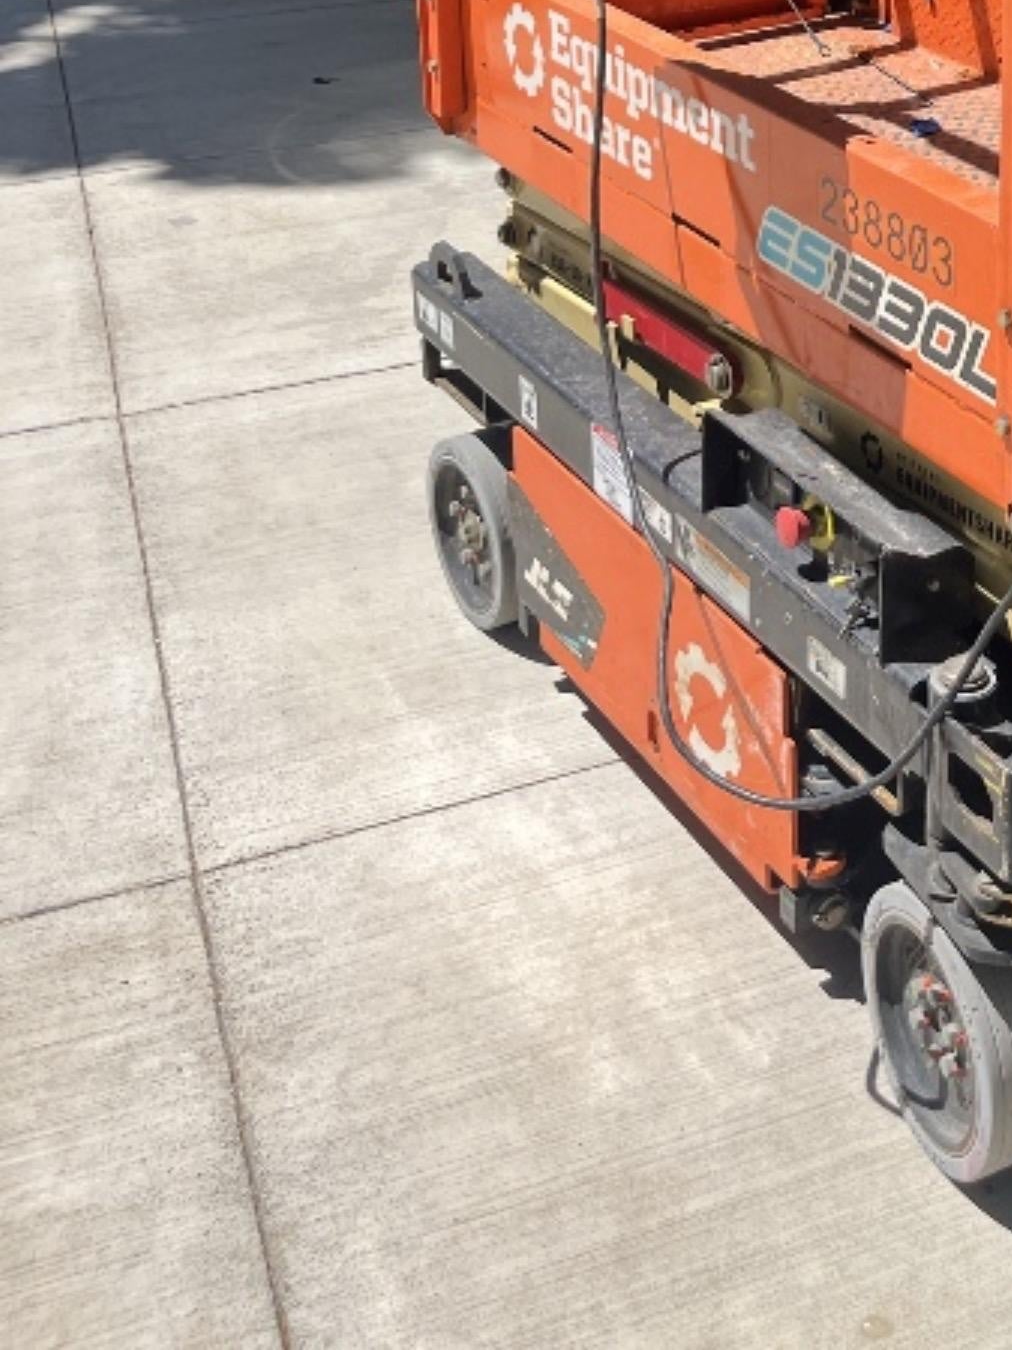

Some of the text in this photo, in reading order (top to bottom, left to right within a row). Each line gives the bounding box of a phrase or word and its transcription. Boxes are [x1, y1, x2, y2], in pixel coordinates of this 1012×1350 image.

[547, 9, 757, 173] Equipment
[550, 75, 653, 182] Share
[819, 177, 954, 287] 238803
[756, 205, 997, 408] ES1330L
